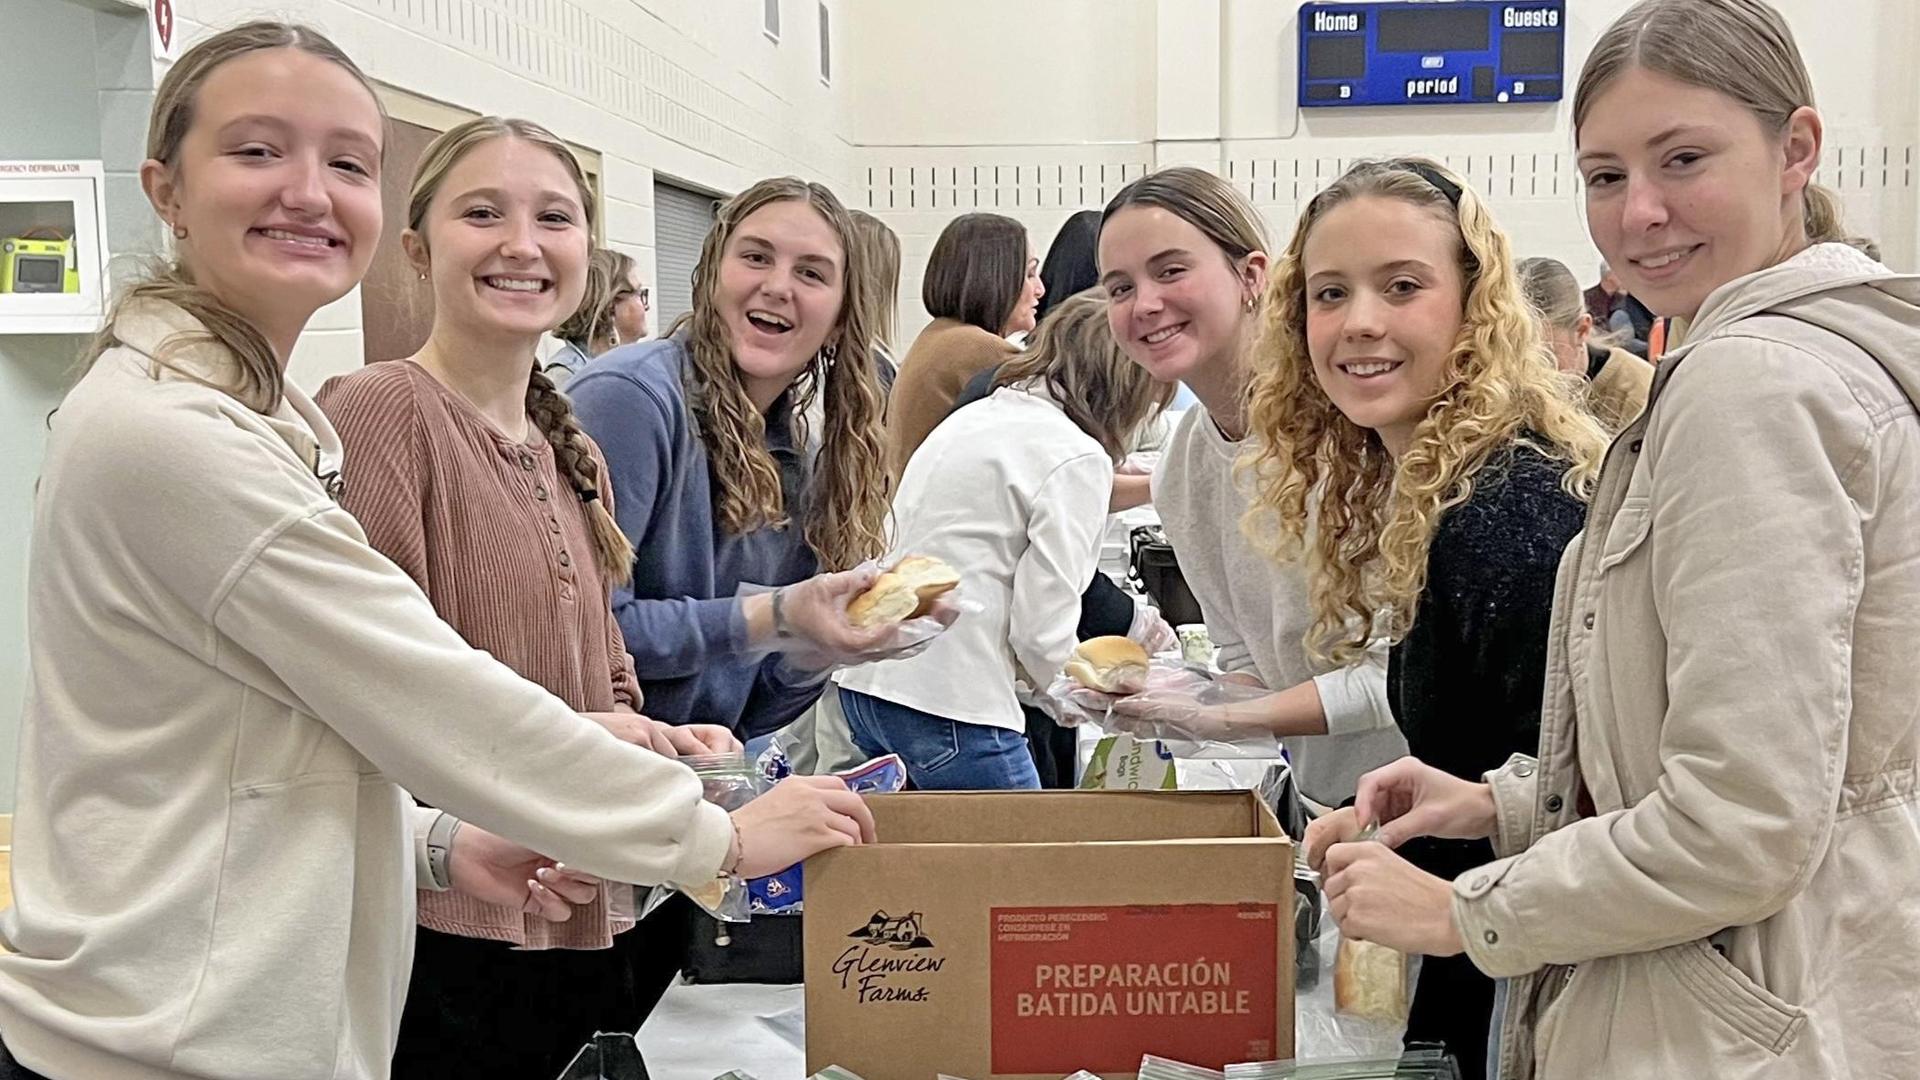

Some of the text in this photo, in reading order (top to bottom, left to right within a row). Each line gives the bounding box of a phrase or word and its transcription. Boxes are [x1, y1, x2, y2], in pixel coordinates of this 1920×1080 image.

[1314, 11, 1358, 32] Home
[1503, 7, 1559, 28] Guests
[1406, 76, 1458, 97] period
[28, 164, 80, 173] DEFIBRILLATOR
[998, 914, 1046, 922] PRODUCTO
[832, 945, 946, 989] Glenview
[1036, 956, 1231, 988] PREPARACIÓN
[1017, 990, 1251, 1017] BATIDA UNTABLE
